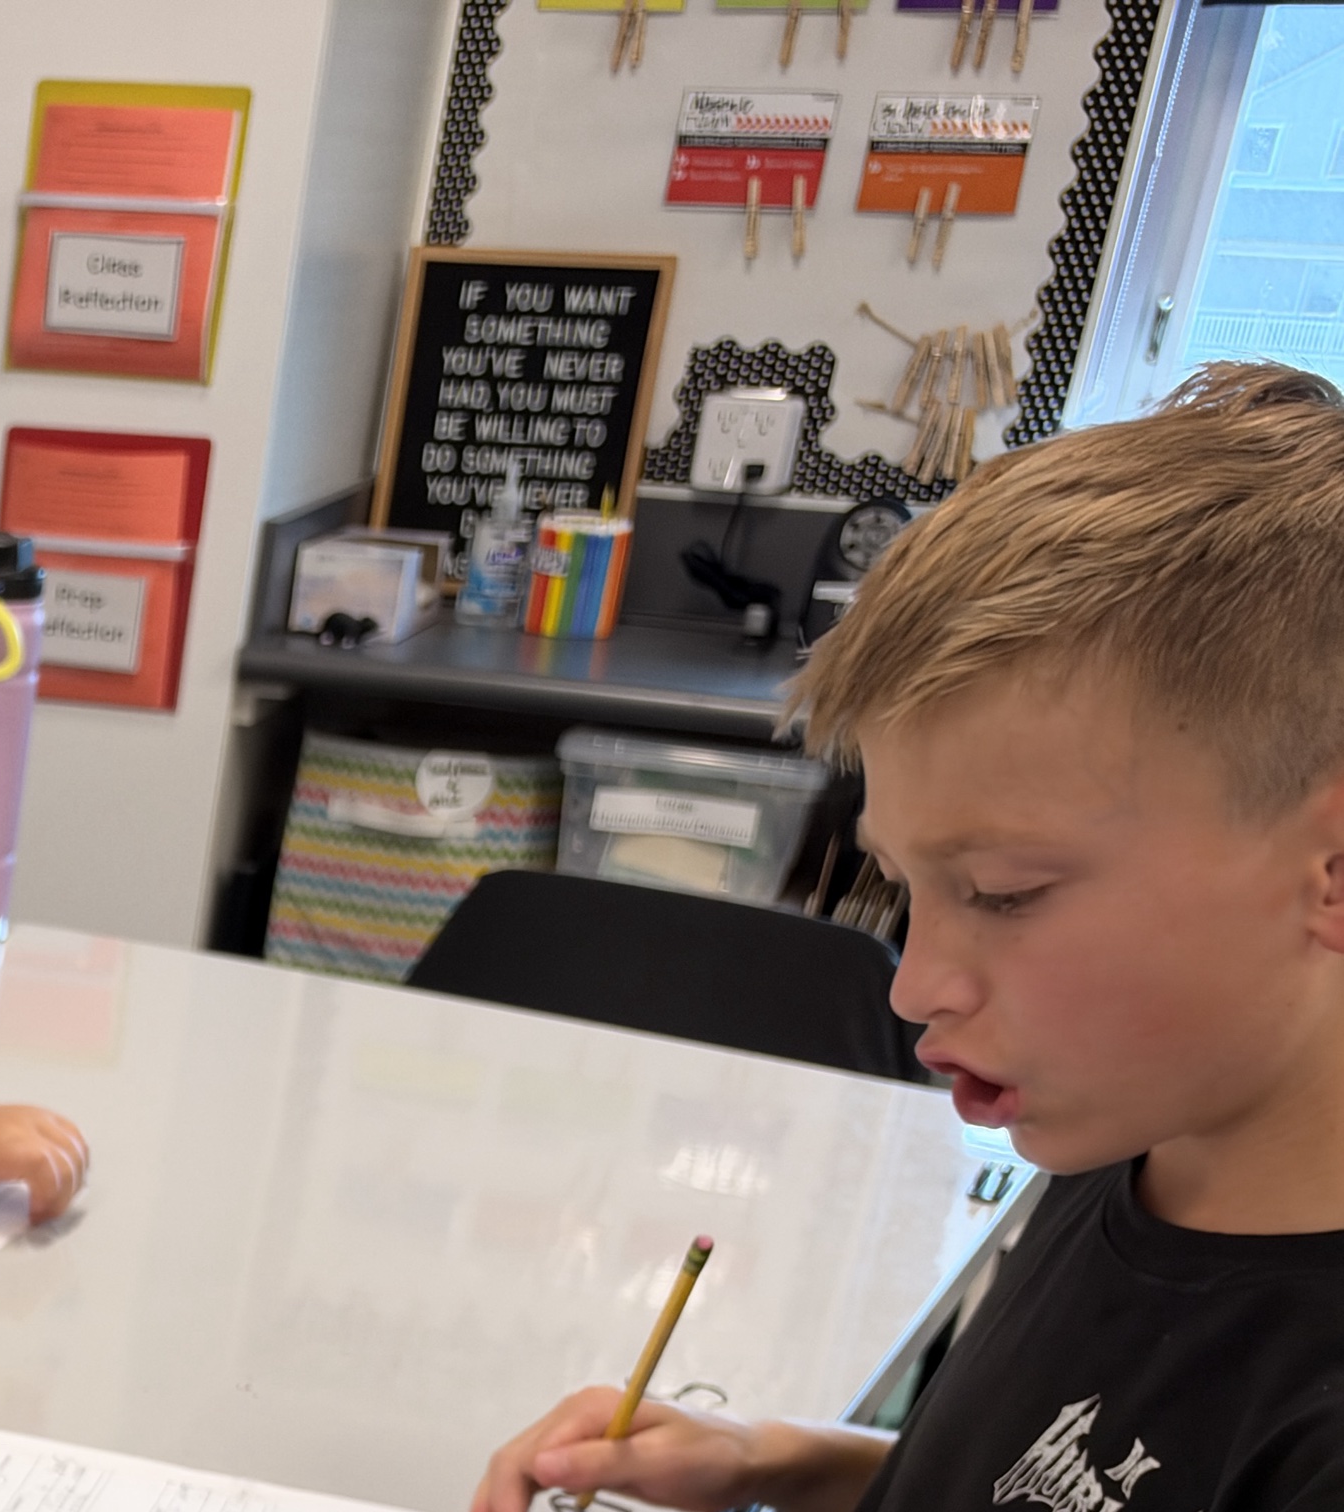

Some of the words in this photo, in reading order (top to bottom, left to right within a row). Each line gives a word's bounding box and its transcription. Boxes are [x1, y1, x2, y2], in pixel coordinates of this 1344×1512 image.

[86, 252, 144, 279] Class
[58, 286, 163, 313] Reflection
[459, 279, 490, 310] IF
[505, 281, 556, 313] YOU
[564, 284, 638, 316] WANT
[464, 314, 612, 349] SOMETHING
[441, 346, 527, 378] YOU'VE
[543, 351, 626, 383] NEVER
[496, 382, 550, 412] YOU
[551, 384, 620, 416] MUST
[433, 411, 470, 441] BE
[475, 413, 573, 447] WILLING
[573, 417, 608, 448] TO
[421, 442, 458, 473] DO
[461, 444, 597, 480] SOMETHING
[518, 480, 591, 509] EVER
[43, 616, 125, 643] eflection
